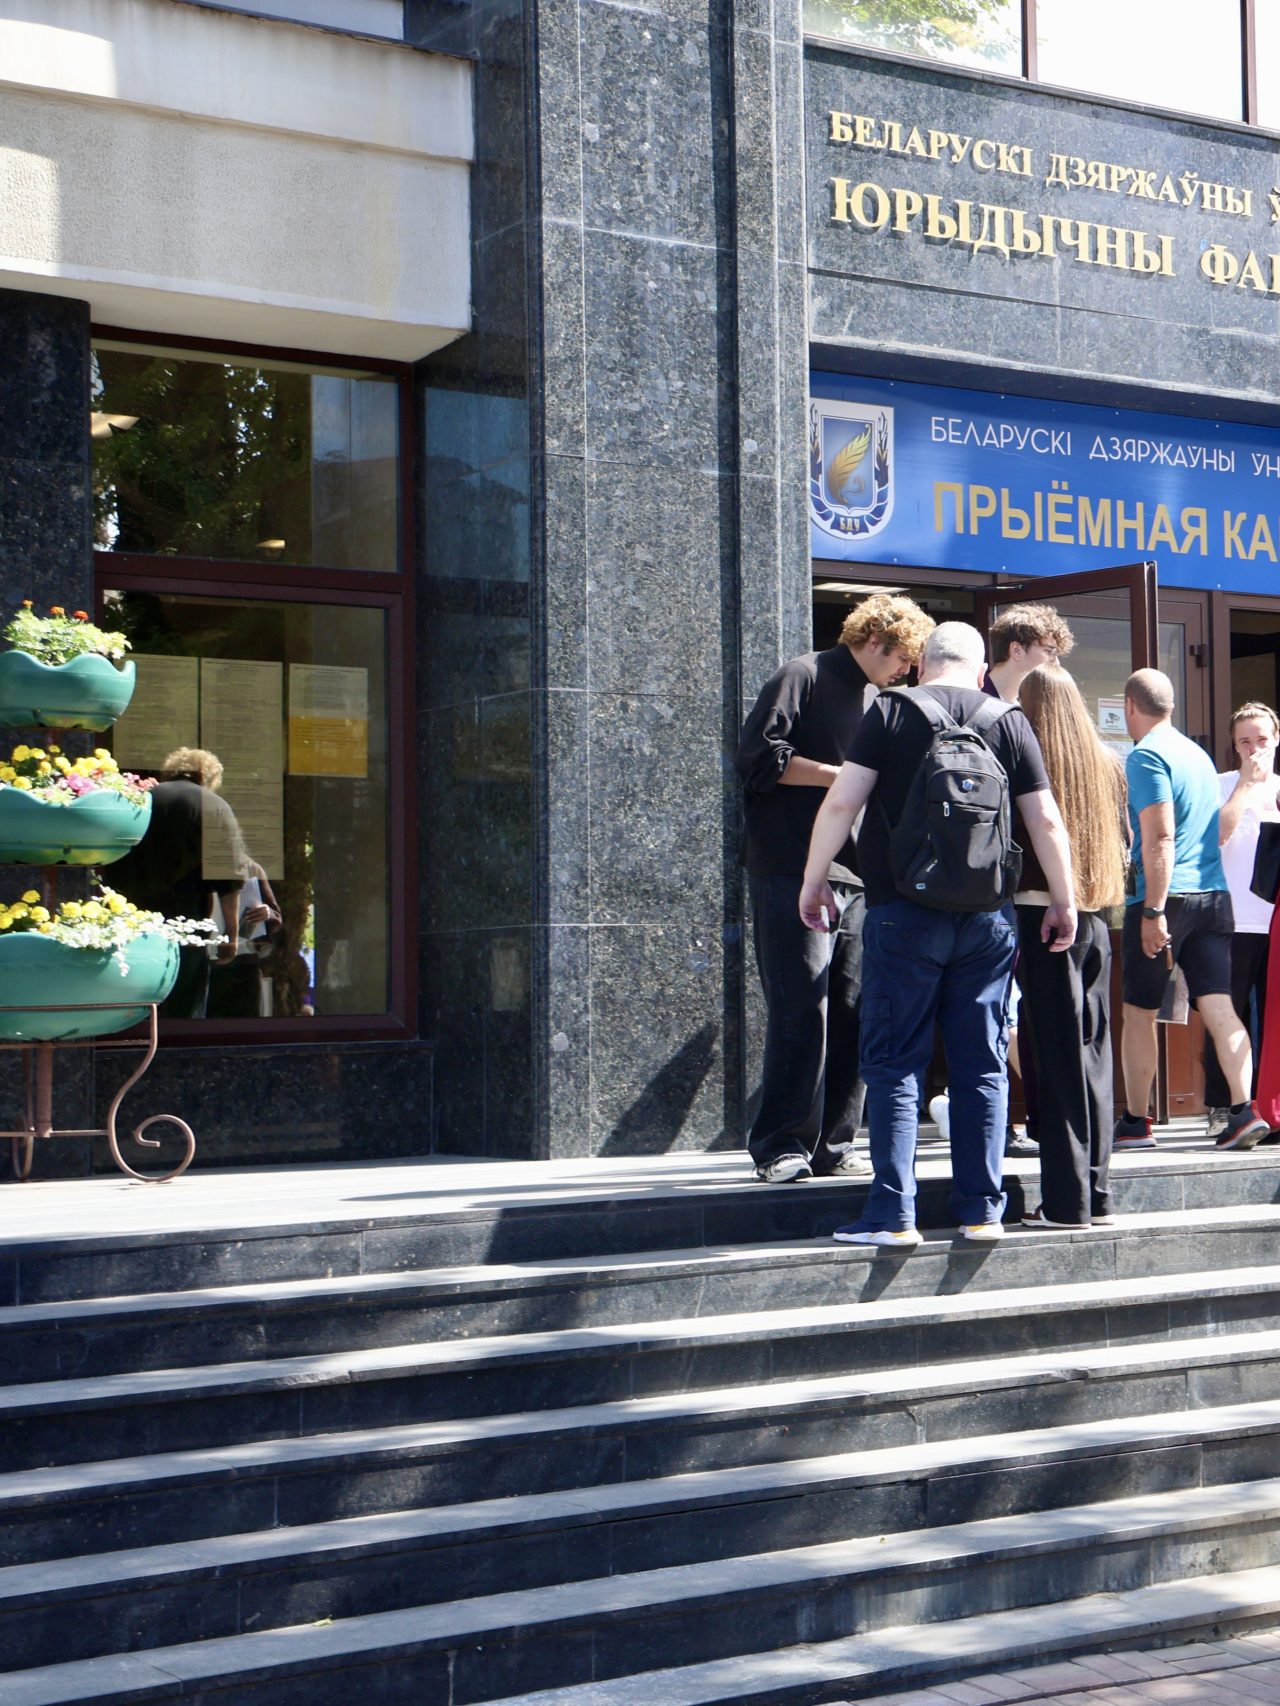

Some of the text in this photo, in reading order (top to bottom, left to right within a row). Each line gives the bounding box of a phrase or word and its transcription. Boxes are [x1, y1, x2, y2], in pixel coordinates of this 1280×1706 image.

[828, 110, 1034, 177] БЕЛАРУСКІ
[1046, 152, 1253, 217] ДЗЯРЖАЎНЫ
[829, 177, 1176, 277] ЮРЫДЫЧНЫ
[930, 416, 1072, 456] БЕЛАРУСКІ
[1089, 435, 1235, 473] ДЗЯРЖАЎНЫ
[934, 480, 1208, 556] ПРЫЁМНАЯ
